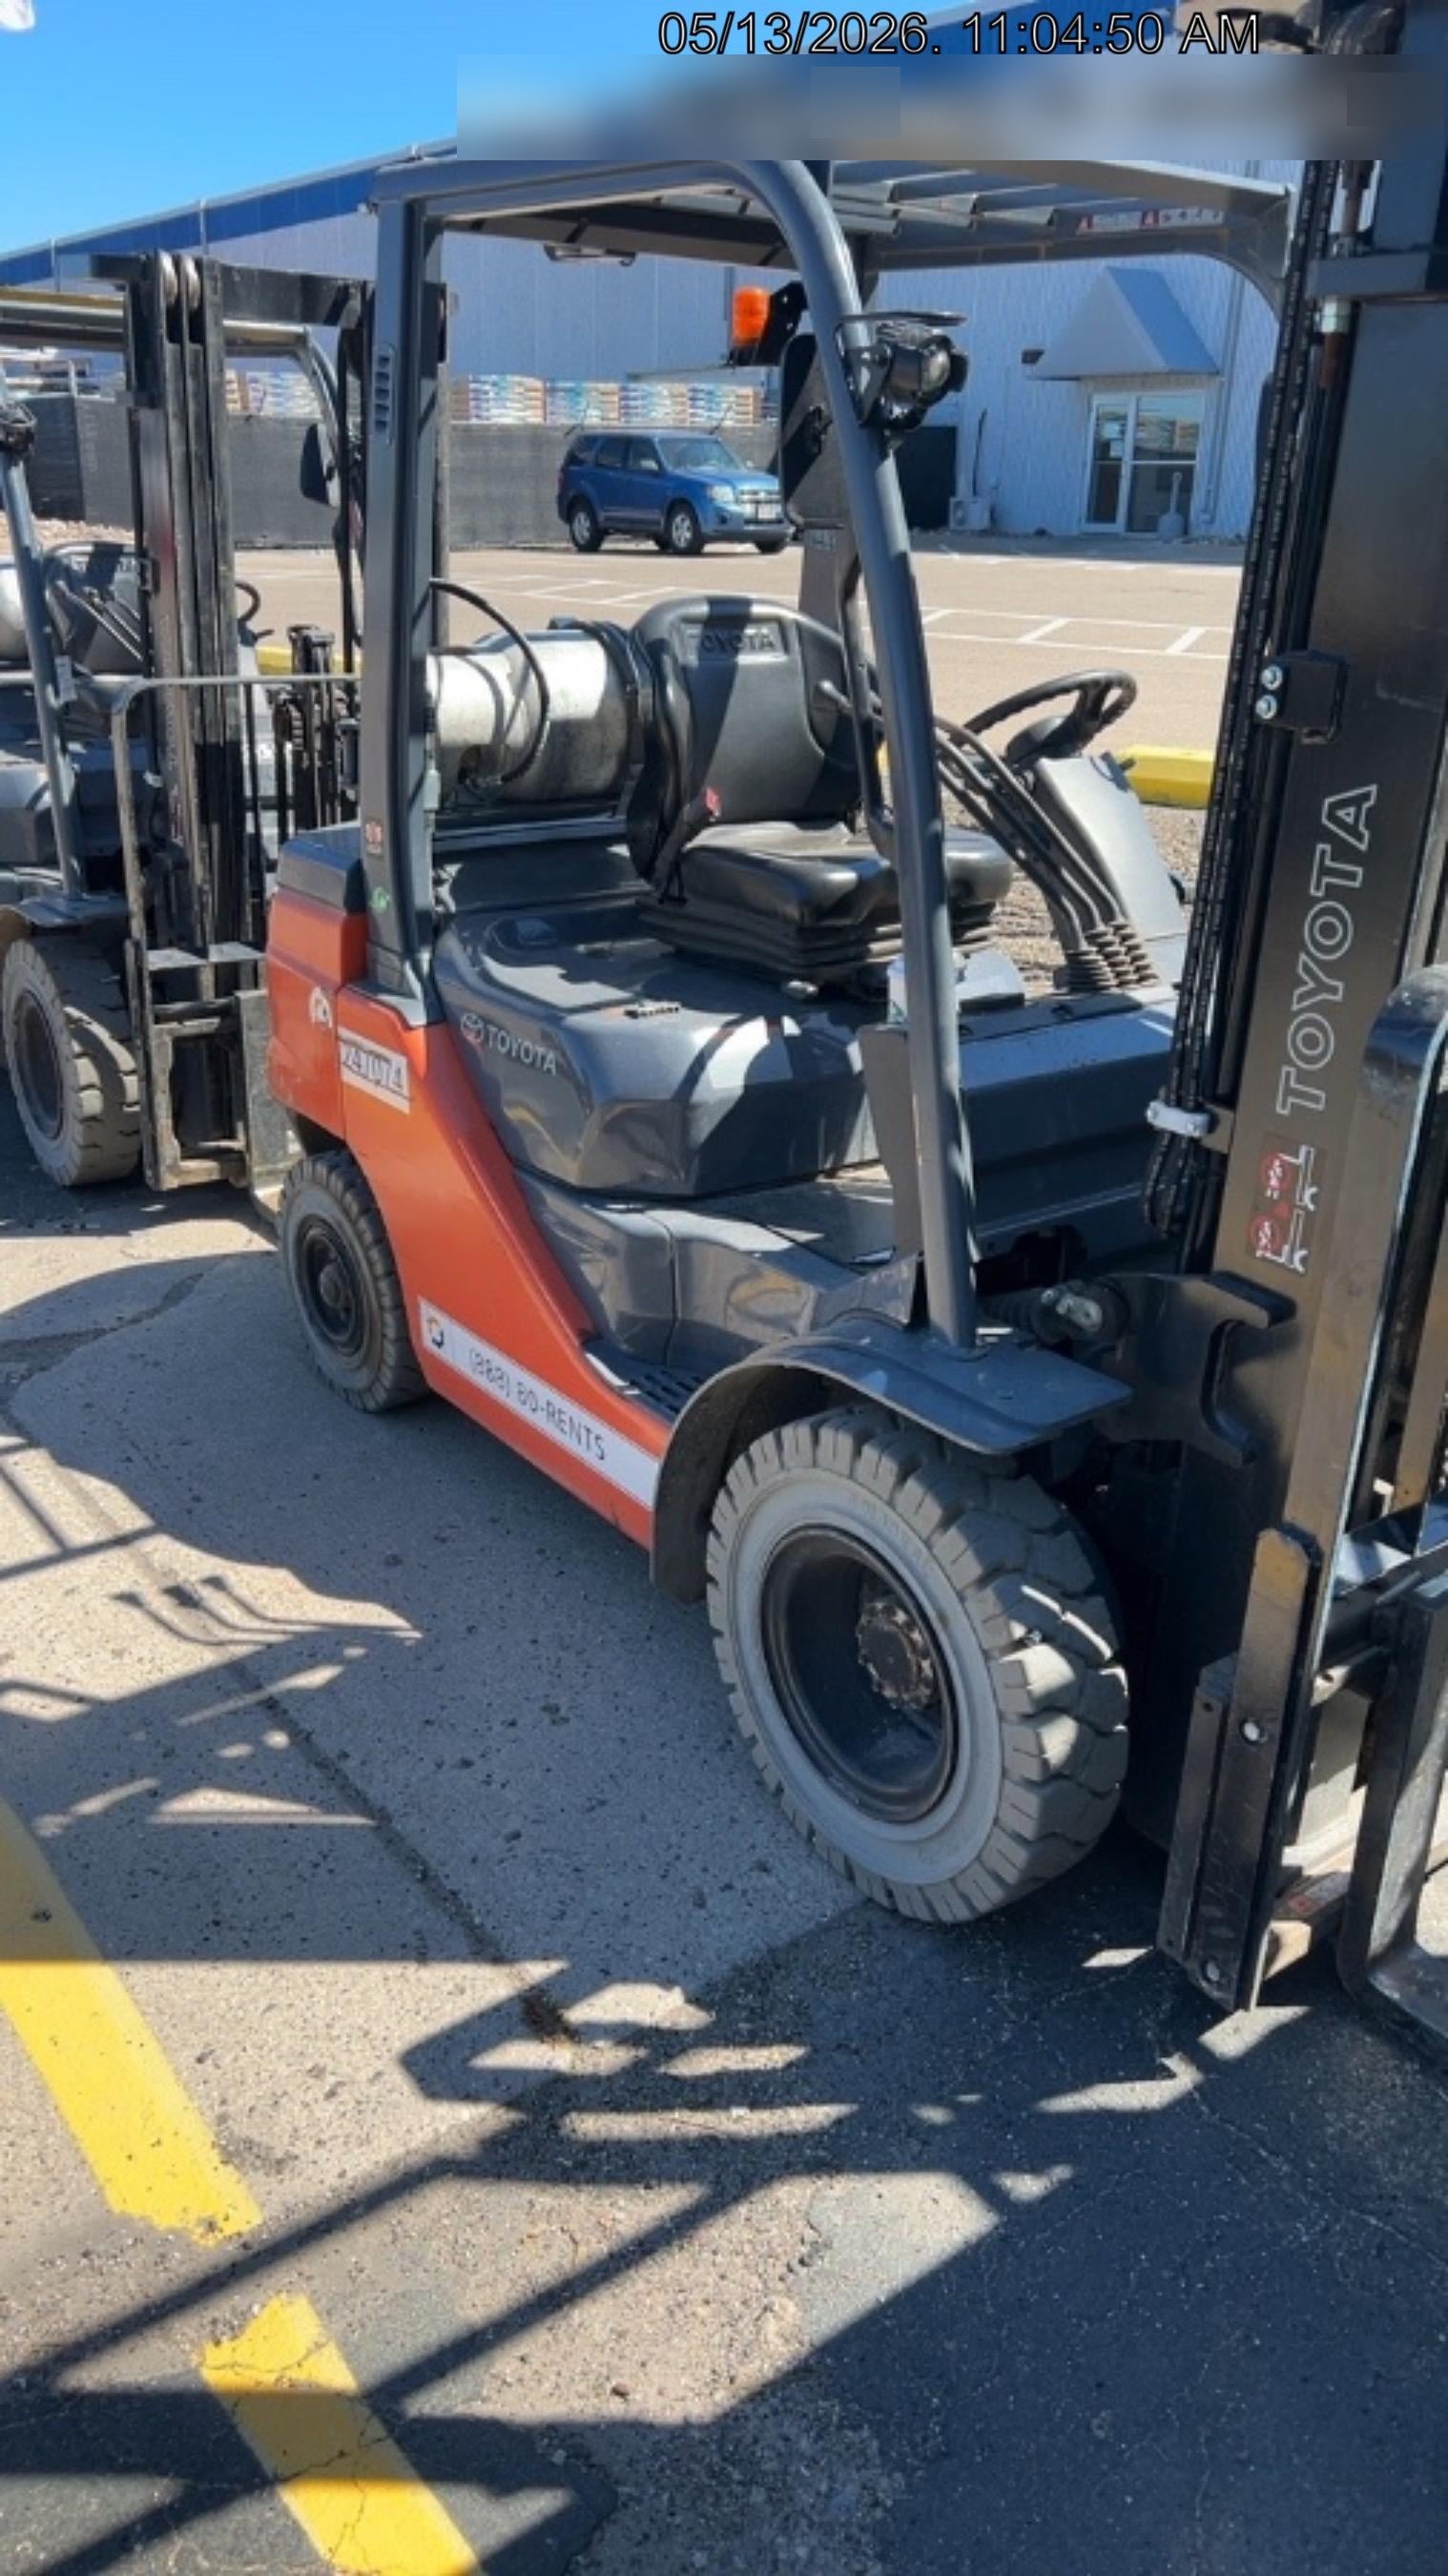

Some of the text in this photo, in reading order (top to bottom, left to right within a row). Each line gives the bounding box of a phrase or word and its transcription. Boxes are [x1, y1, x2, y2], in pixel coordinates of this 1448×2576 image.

[1275, 782, 1378, 1116] TOYOTA
[486, 1023, 557, 1077] TOYOTA
[468, 1346, 606, 1462] (888) 80-RENTS
